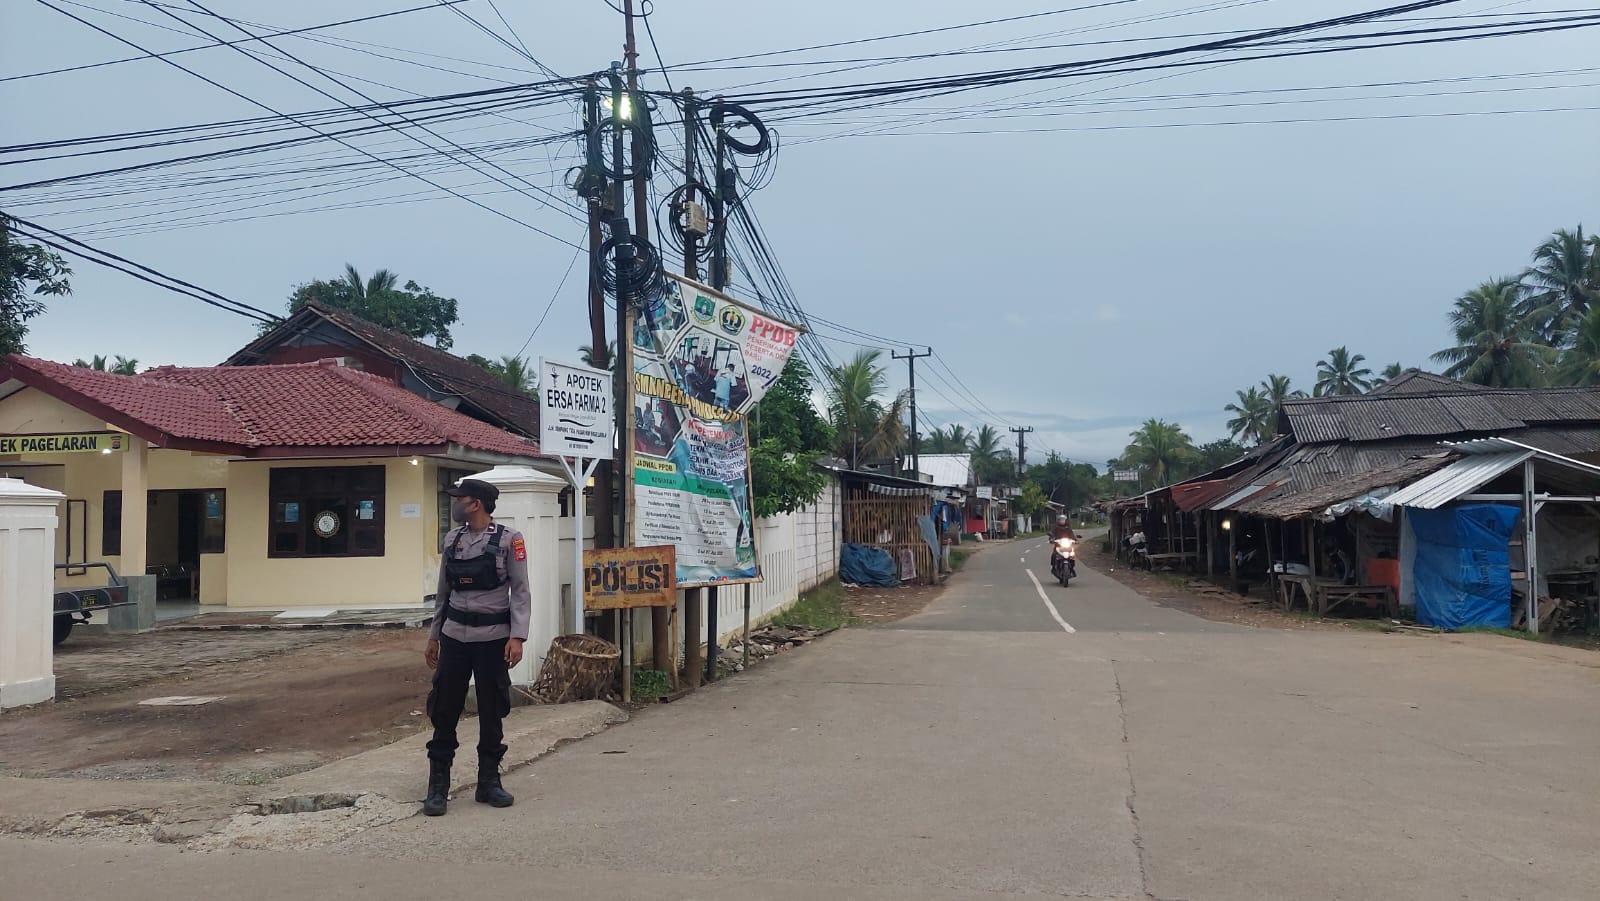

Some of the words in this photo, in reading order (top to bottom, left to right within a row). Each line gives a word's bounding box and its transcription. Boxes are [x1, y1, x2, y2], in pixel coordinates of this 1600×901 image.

[749, 314, 796, 347] PPDB
[566, 373, 603, 393] APOTEK
[547, 389, 574, 411] ERSA
[574, 393, 600, 414] FARMA
[601, 396, 606, 414] 2
[21, 436, 97, 451] PAGELARAN
[636, 459, 657, 470] JADWAL
[585, 564, 669, 592] POLISI
